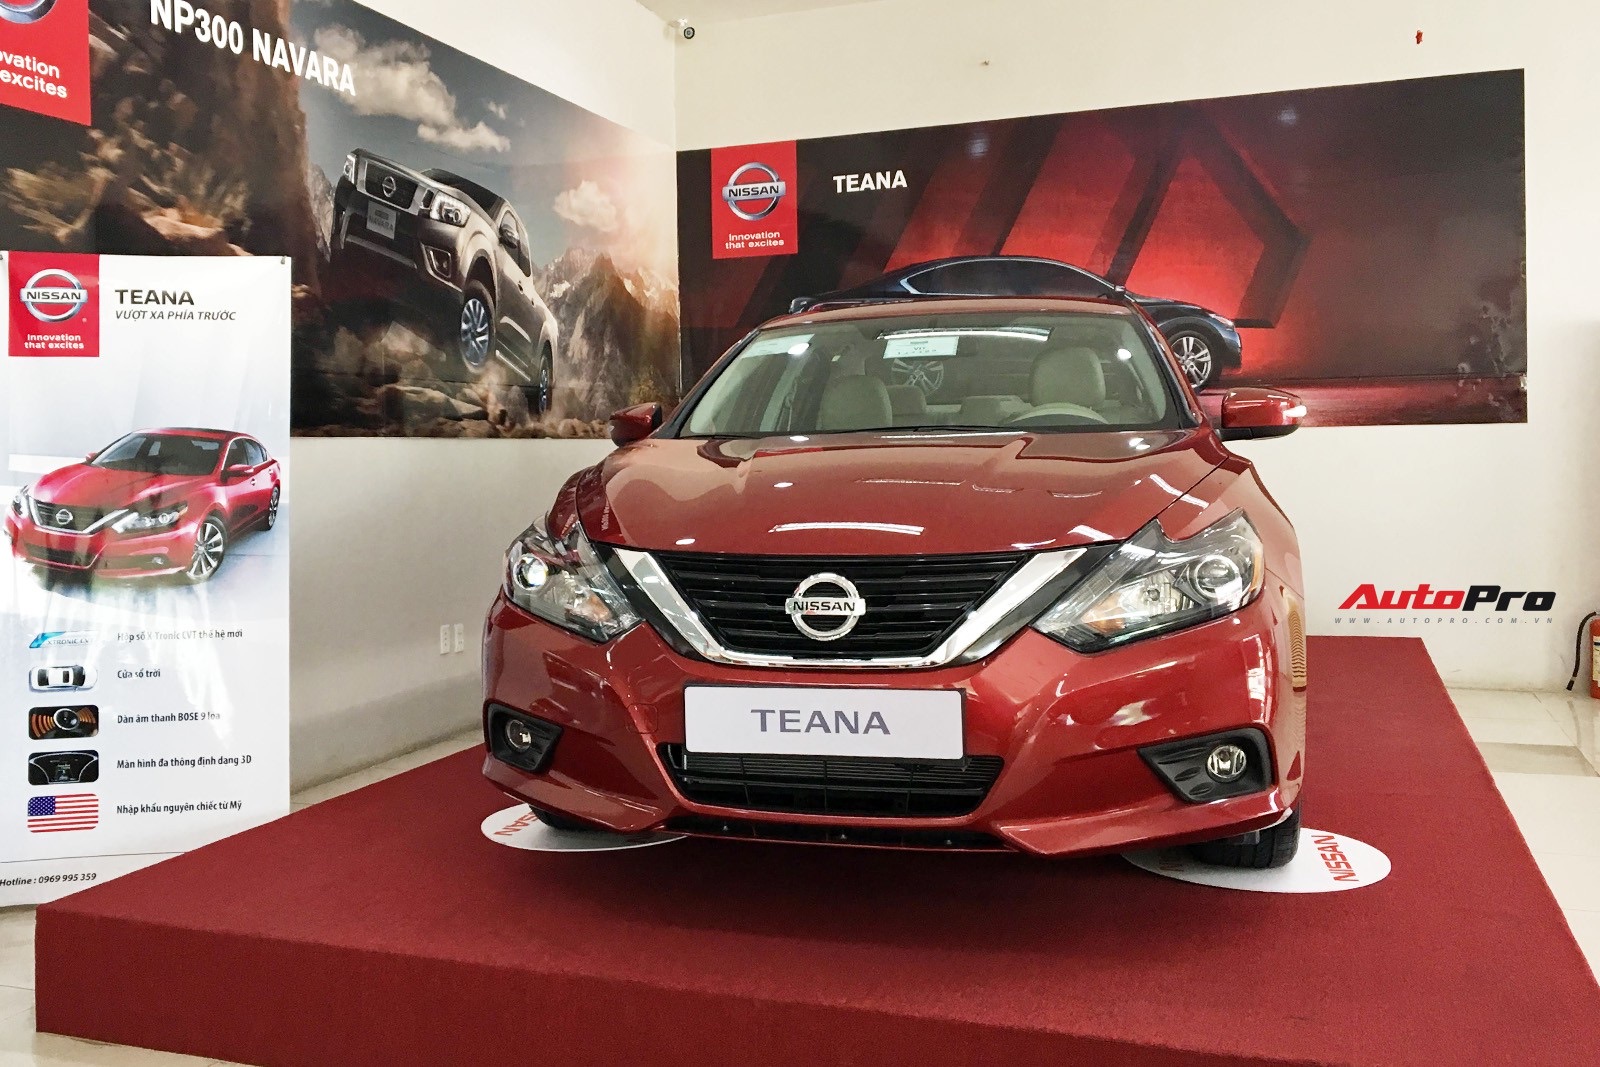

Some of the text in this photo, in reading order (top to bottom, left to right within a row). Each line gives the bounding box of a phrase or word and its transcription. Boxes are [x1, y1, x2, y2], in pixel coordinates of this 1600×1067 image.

[151, 0, 356, 96] NP300 NAVARA
[0, 69, 67, 98] excites
[832, 170, 907, 193] TEANA
[728, 185, 779, 198] NISSAN
[728, 231, 780, 241] Innovation
[725, 238, 784, 249] that excites
[27, 291, 81, 300] NISSAN
[115, 289, 195, 306] TEANA
[116, 309, 237, 322] VƯỢT XA PHÍA TRƯỚC
[27, 333, 81, 341] Innovation
[792, 600, 856, 612] NISSAN
[155, 631, 180, 640] Tronic
[182, 630, 197, 639] CVT
[215, 629, 225, 641] hệ
[227, 629, 243, 638] mới
[145, 668, 160, 678] trời
[117, 711, 220, 723] Dàn âm thanh BOSE 9 loa
[751, 709, 891, 735] TEANA
[117, 759, 135, 768] Màn
[137, 758, 156, 768] hình
[158, 758, 169, 767] đa
[170, 757, 196, 768] thông
[198, 756, 216, 768] định
[241, 755, 252, 764] 3D
[117, 804, 139, 816] Nhập
[163, 802, 194, 814] nguyên
[196, 800, 217, 811] chiếc
[219, 800, 228, 810] từ
[230, 800, 242, 811] Mỹ
[1311, 834, 1359, 883] NISSAN
[0, 877, 32, 887] Hotline
[38, 875, 61, 884] 0969
[62, 873, 79, 882] 995
[80, 872, 97, 881] 359
